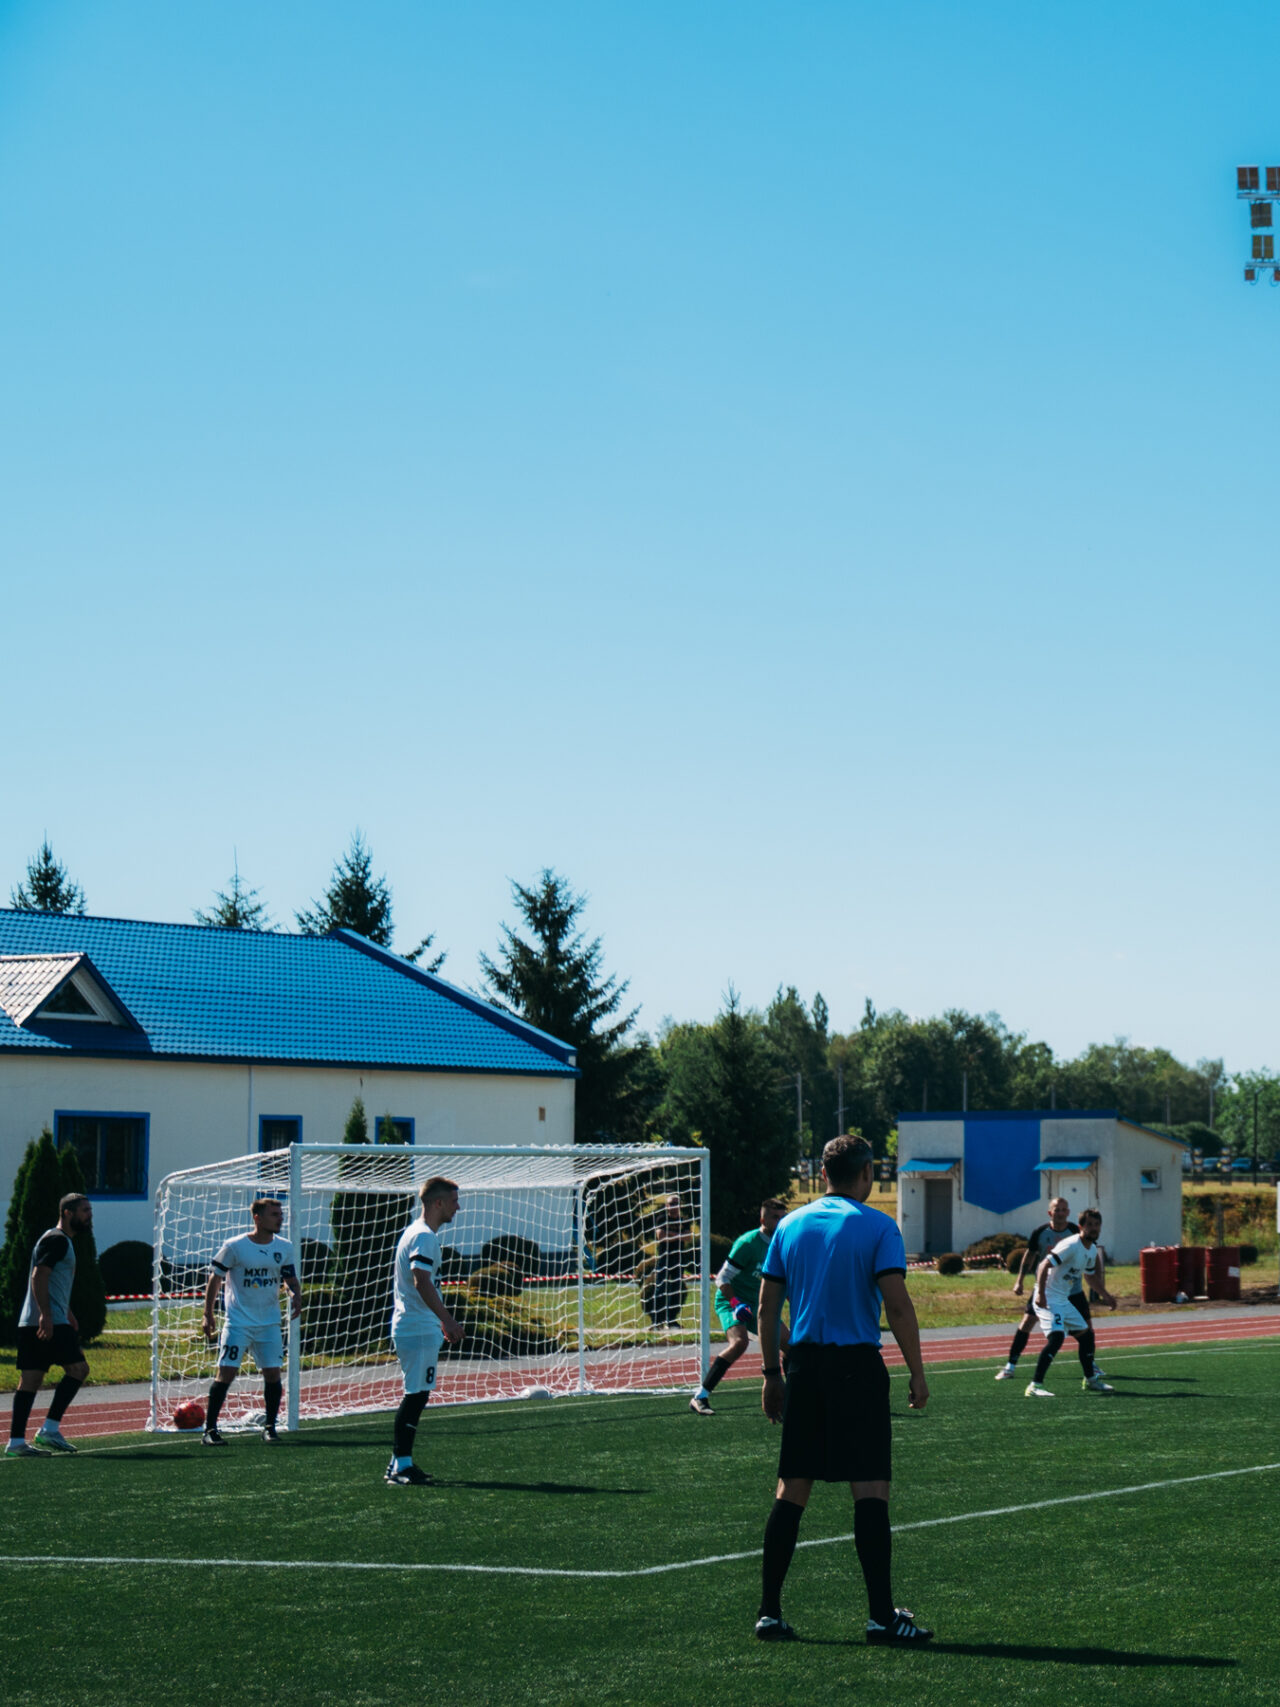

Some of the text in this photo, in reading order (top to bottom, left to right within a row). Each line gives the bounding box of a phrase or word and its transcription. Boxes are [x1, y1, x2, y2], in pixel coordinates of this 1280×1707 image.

[244, 1267, 268, 1277] МХП
[1054, 1313, 1063, 1326] 2
[425, 1366, 435, 1385] 8
